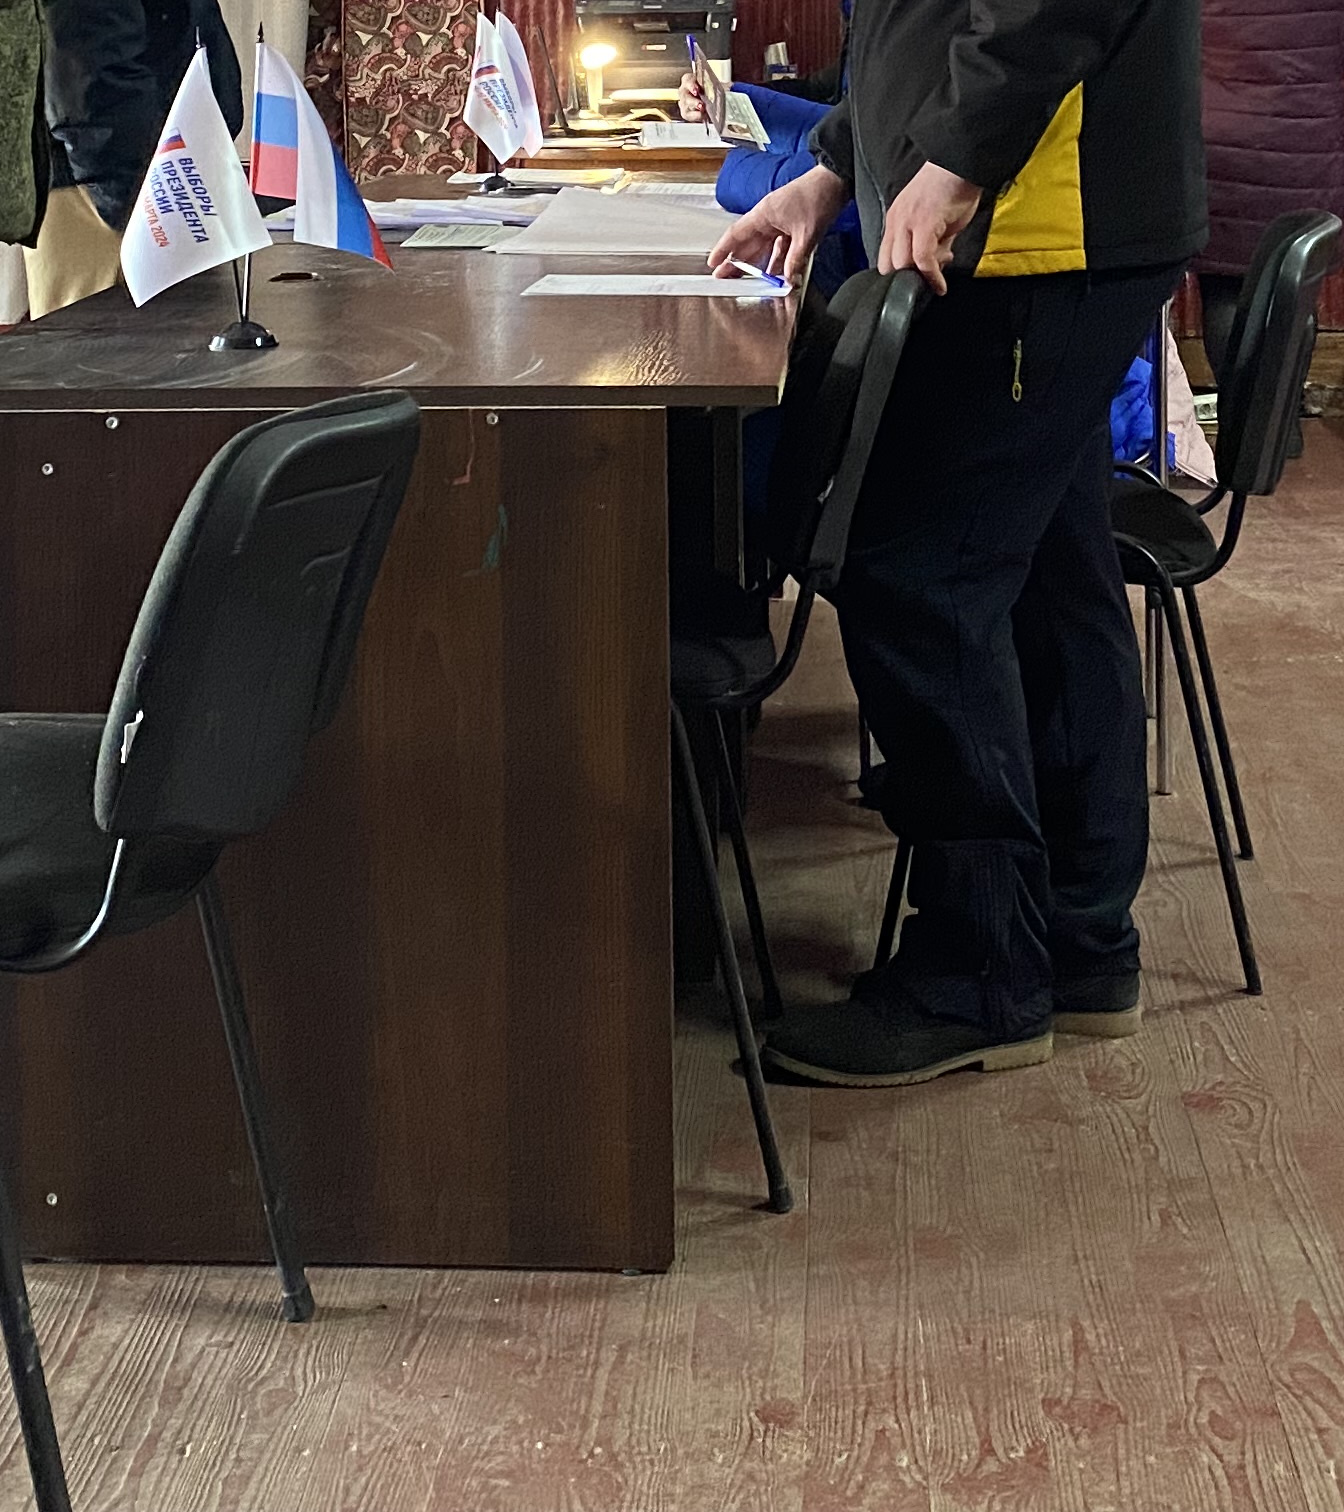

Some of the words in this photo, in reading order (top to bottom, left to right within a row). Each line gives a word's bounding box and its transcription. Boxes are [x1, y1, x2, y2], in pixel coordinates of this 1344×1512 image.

[161, 160, 210, 244] ПРЕЗИДЕНТА
[178, 157, 218, 216] ВЫБОРЫ
[151, 226, 171, 248] 2024
